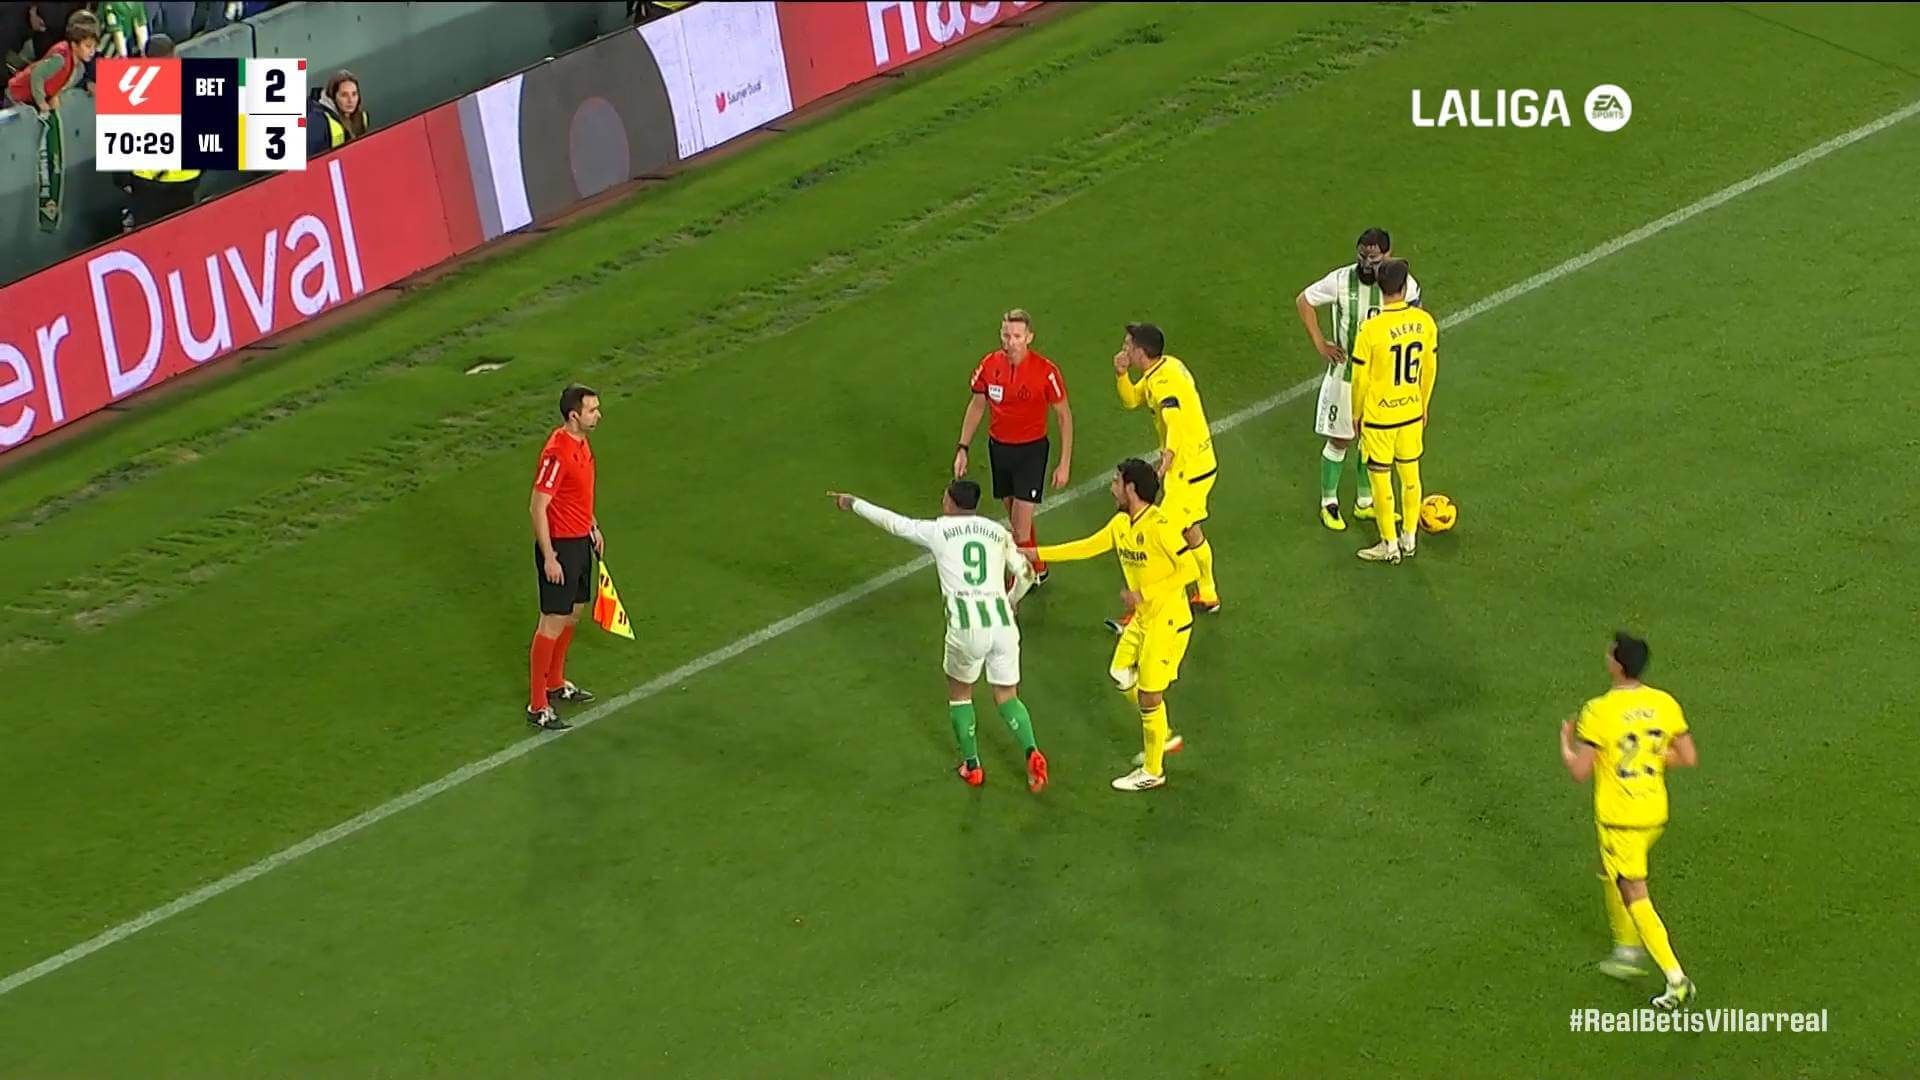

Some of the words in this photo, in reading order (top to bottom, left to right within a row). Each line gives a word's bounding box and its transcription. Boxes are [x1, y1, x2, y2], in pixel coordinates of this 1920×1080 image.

[866, 1, 1026, 67] Has
[87, 160, 364, 399] Duval
[1389, 341, 1423, 387] 16
[1328, 404, 1338, 422] 8
[963, 541, 987, 586] 9
